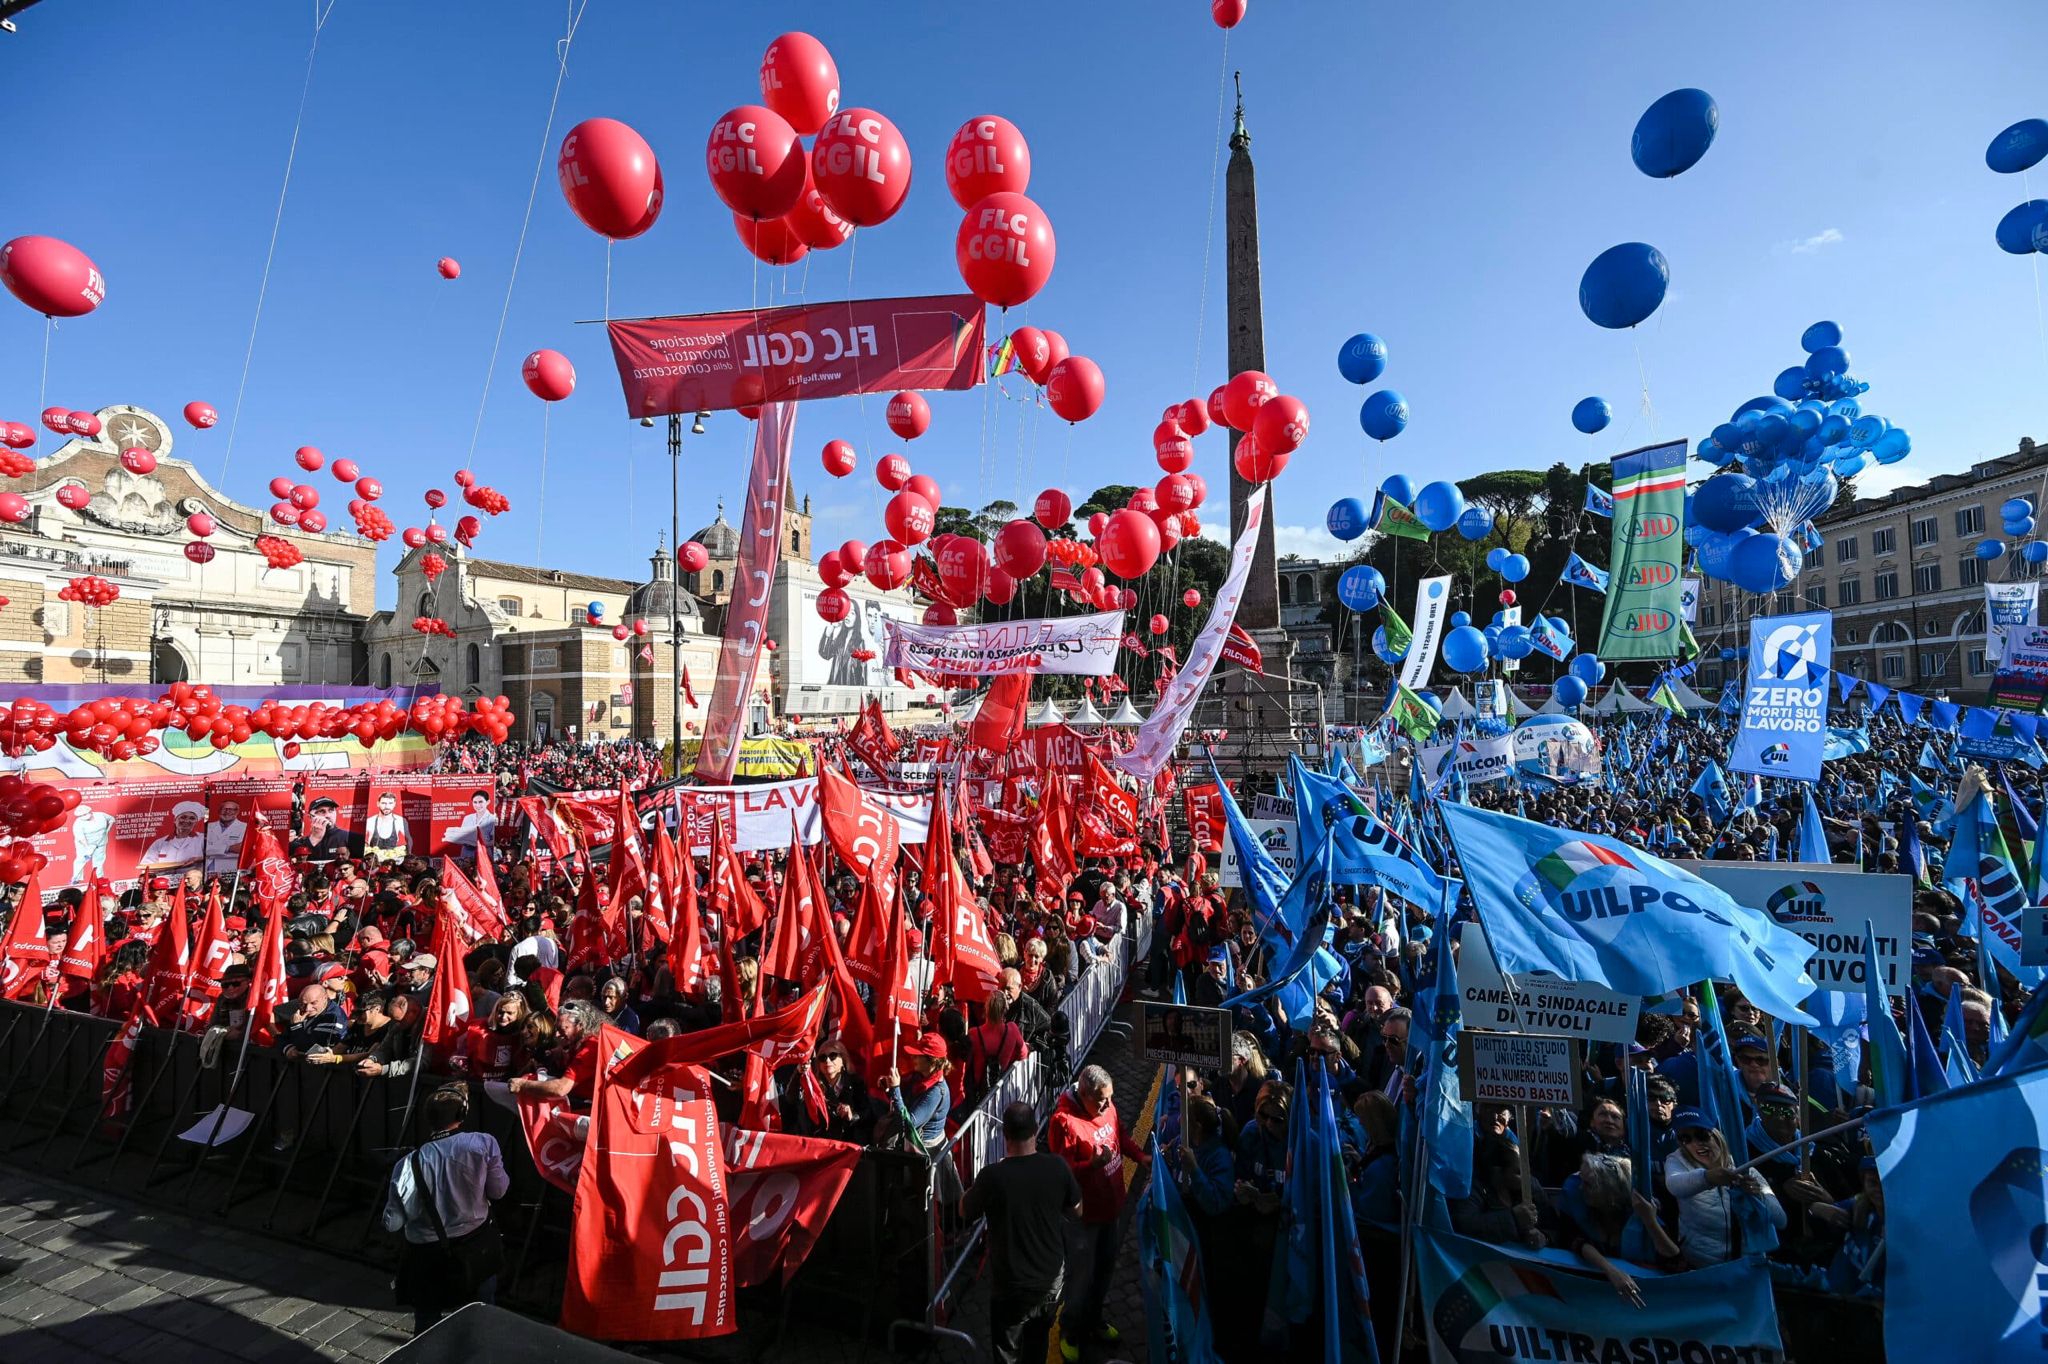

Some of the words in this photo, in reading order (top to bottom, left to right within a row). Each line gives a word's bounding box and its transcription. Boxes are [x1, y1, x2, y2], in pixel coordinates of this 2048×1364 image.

[713, 122, 756, 143] FLC
[822, 114, 882, 144] FLC
[709, 147, 763, 175] CGIL
[814, 142, 885, 185] CGIL
[979, 208, 1027, 235] FLC
[968, 235, 1030, 267] CGIL
[903, 518, 930, 535] CGIL
[941, 551, 964, 562] FLC
[1749, 687, 1823, 708] ZERO
[1747, 707, 1792, 718] MORTI
[1795, 708, 1822, 719] SUL
[1744, 716, 1821, 733] LAVORO
[1046, 736, 1082, 766] ACEA
[1771, 753, 1789, 762] UIL
[696, 793, 729, 804] CGIL
[1257, 795, 1269, 810] UIL
[687, 806, 696, 837] ROMA
[1268, 838, 1287, 847] UIL
[1788, 901, 1826, 916] UIL
[1466, 986, 1531, 1007] CAMERA
[1537, 994, 1628, 1017] SINDACALE
[1497, 1008, 1516, 1024] DI
[1525, 1009, 1592, 1032] TIVOLI
[1474, 1037, 1508, 1051] DIRITTO
[1510, 1039, 1533, 1053] ALLO
[1534, 1041, 1566, 1056] STUDIO
[1494, 1052, 1548, 1068] UNIVERSALE
[1476, 1067, 1488, 1080] NO
[1490, 1068, 1500, 1081] AL
[1502, 1069, 1536, 1083] NUMERO
[1538, 1071, 1569, 1085] CHIUSO
[1478, 1084, 1526, 1099] ADESSO
[1530, 1087, 1570, 1102] BASTA
